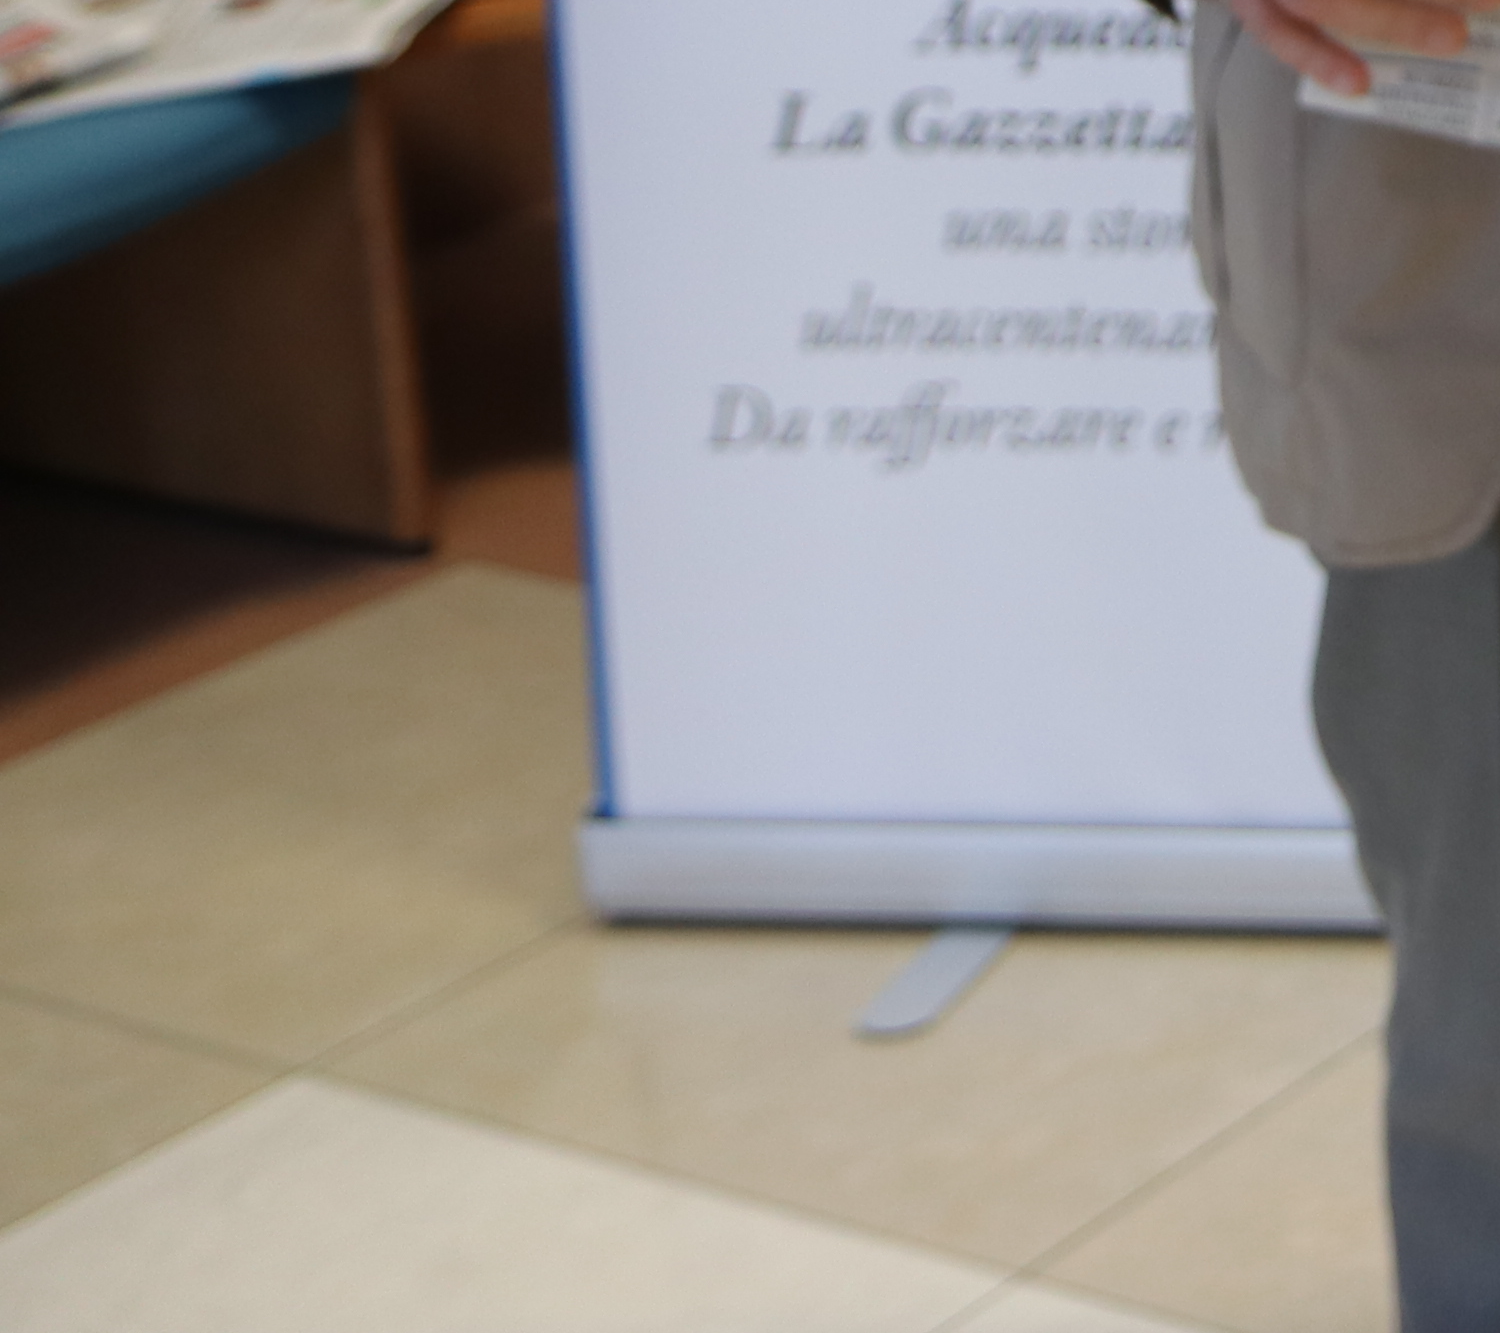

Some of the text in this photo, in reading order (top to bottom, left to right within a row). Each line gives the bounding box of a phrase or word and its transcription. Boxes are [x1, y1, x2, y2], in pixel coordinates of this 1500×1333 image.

[772, 86, 1196, 155] La Gazzetta
[944, 208, 1068, 253] una
[709, 383, 810, 451] Da
[826, 378, 1147, 475] rafforzare
[1155, 409, 1191, 450] e
